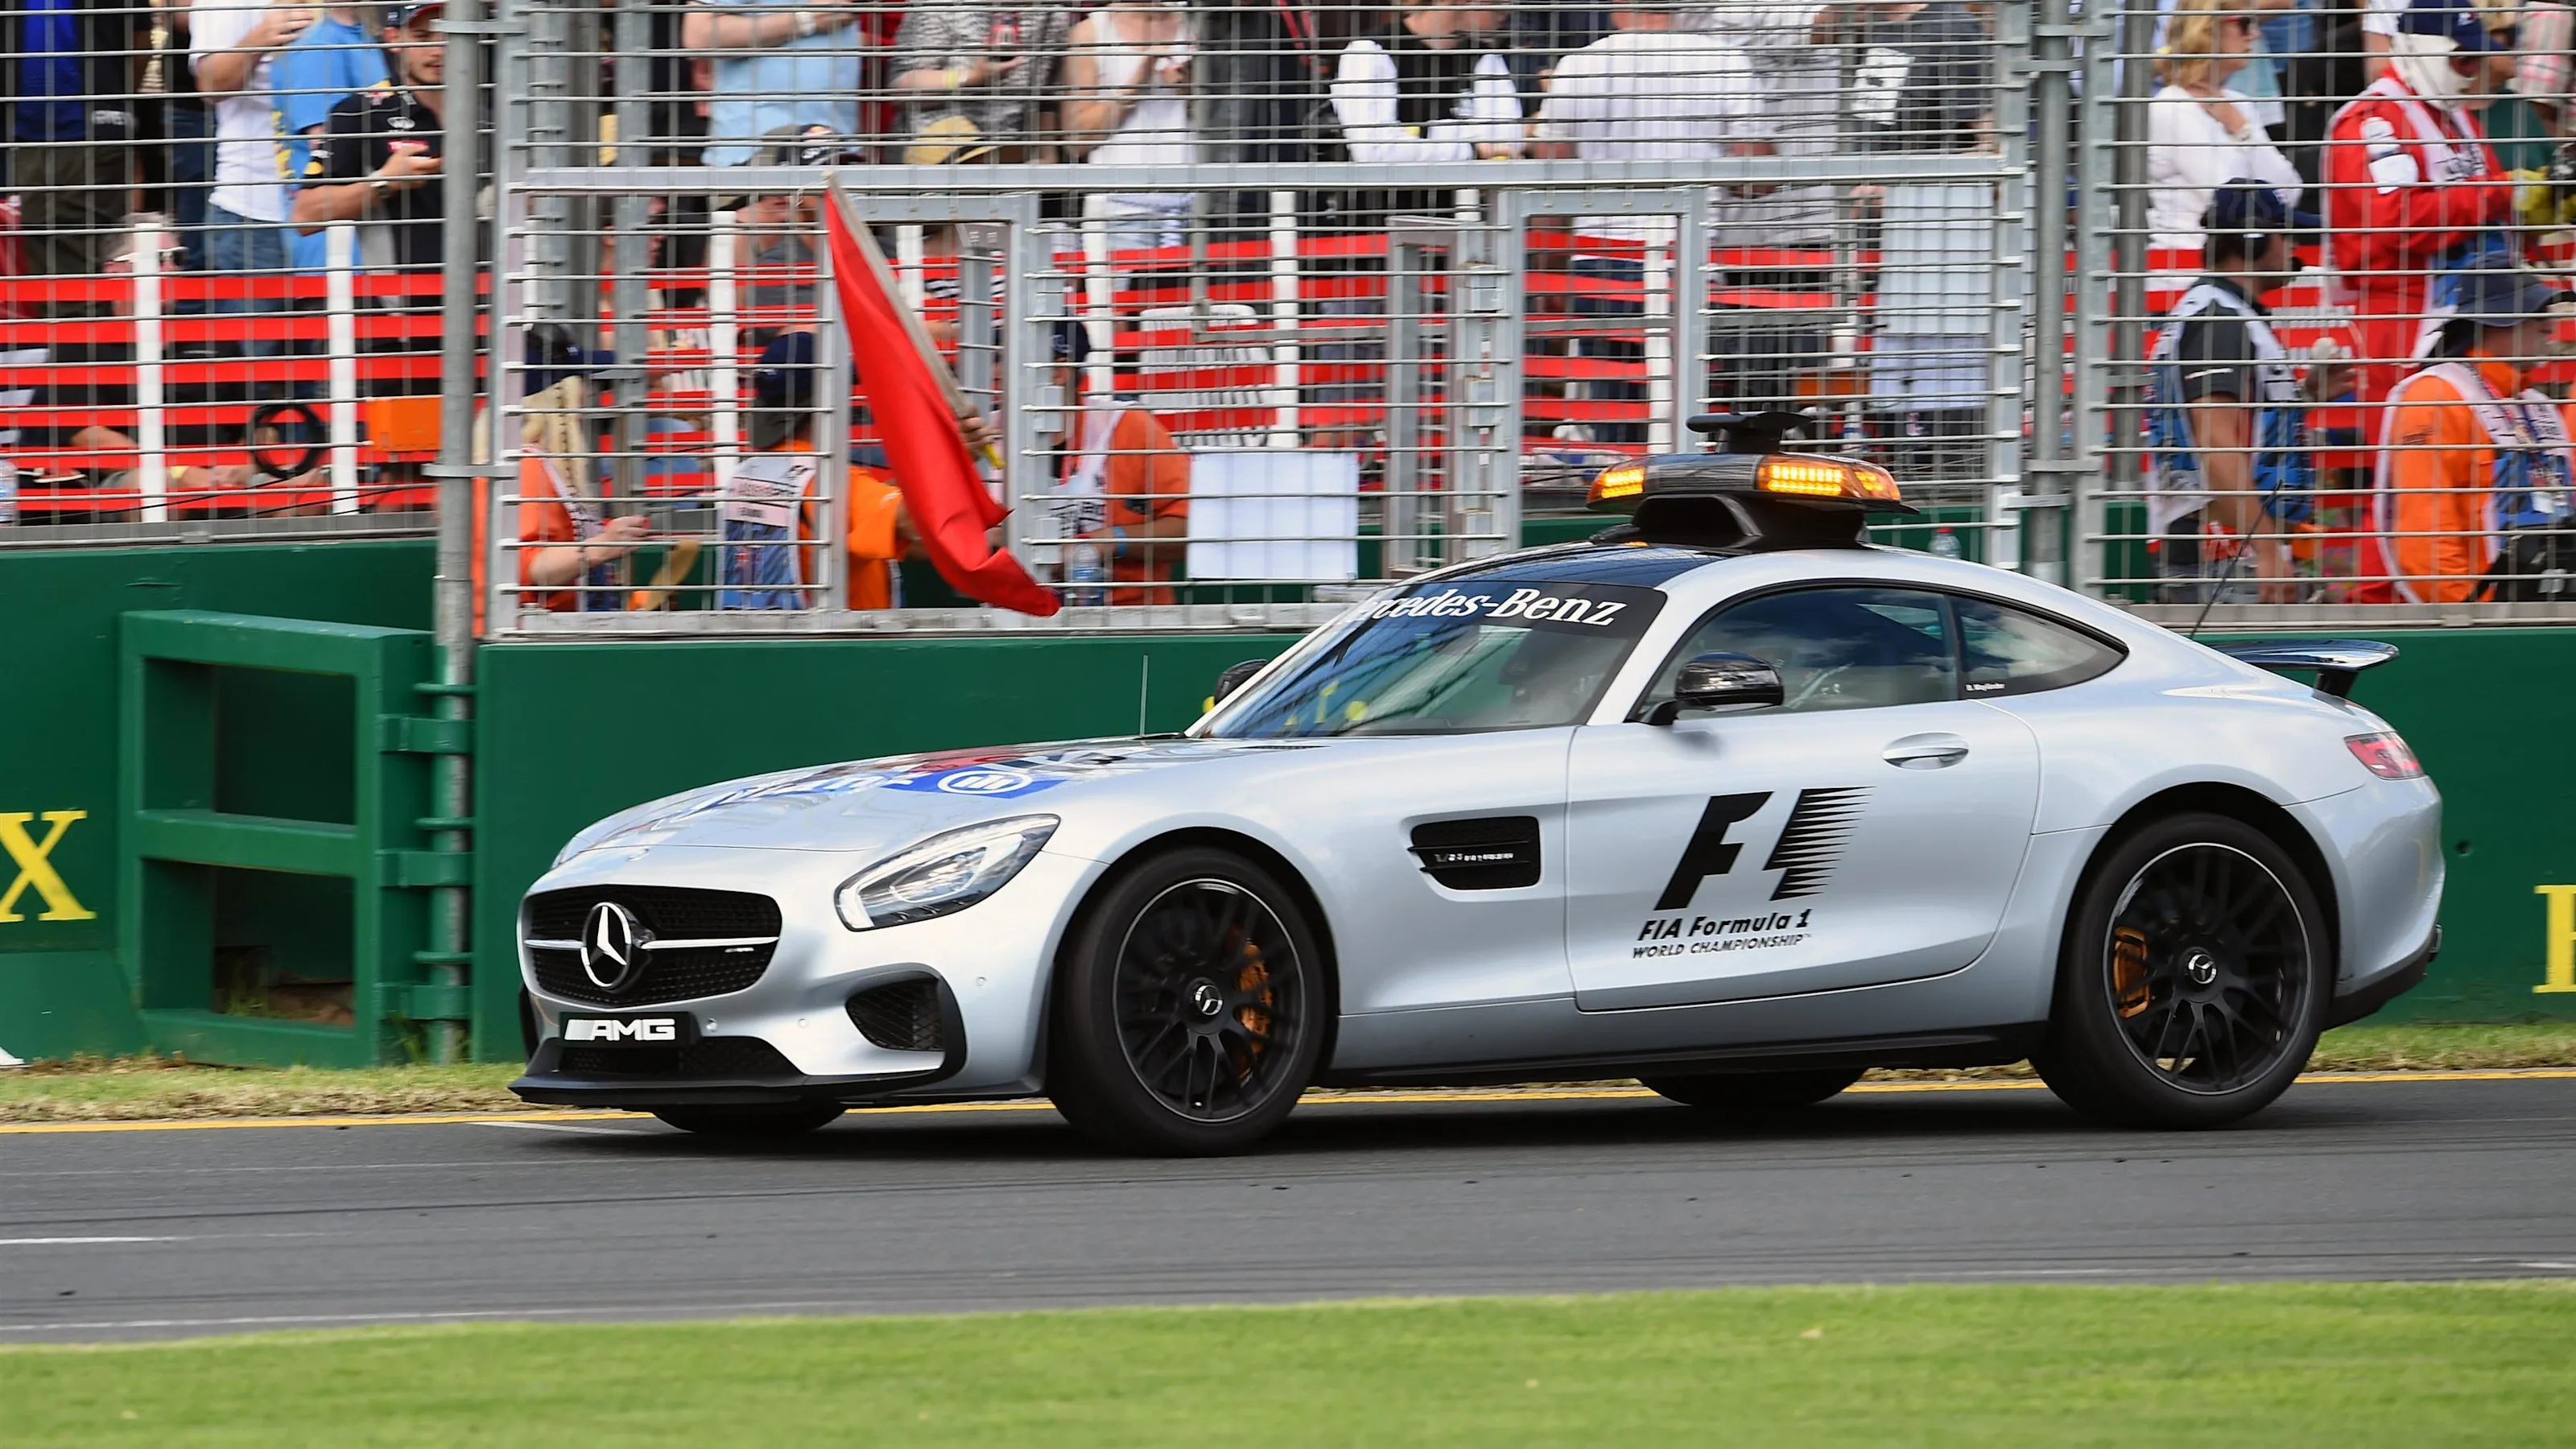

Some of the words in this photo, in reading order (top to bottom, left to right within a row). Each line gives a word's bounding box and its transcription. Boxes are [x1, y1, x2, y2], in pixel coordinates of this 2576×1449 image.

[1338, 588, 1627, 627] rcedes-Benz
[1653, 786, 1877, 910] F1
[1637, 918, 1683, 941] FIA
[1687, 912, 1792, 937] Formula
[1795, 908, 1813, 929] 1
[1633, 943, 1685, 959] WORLD
[591, 1018, 675, 1041] AMG
